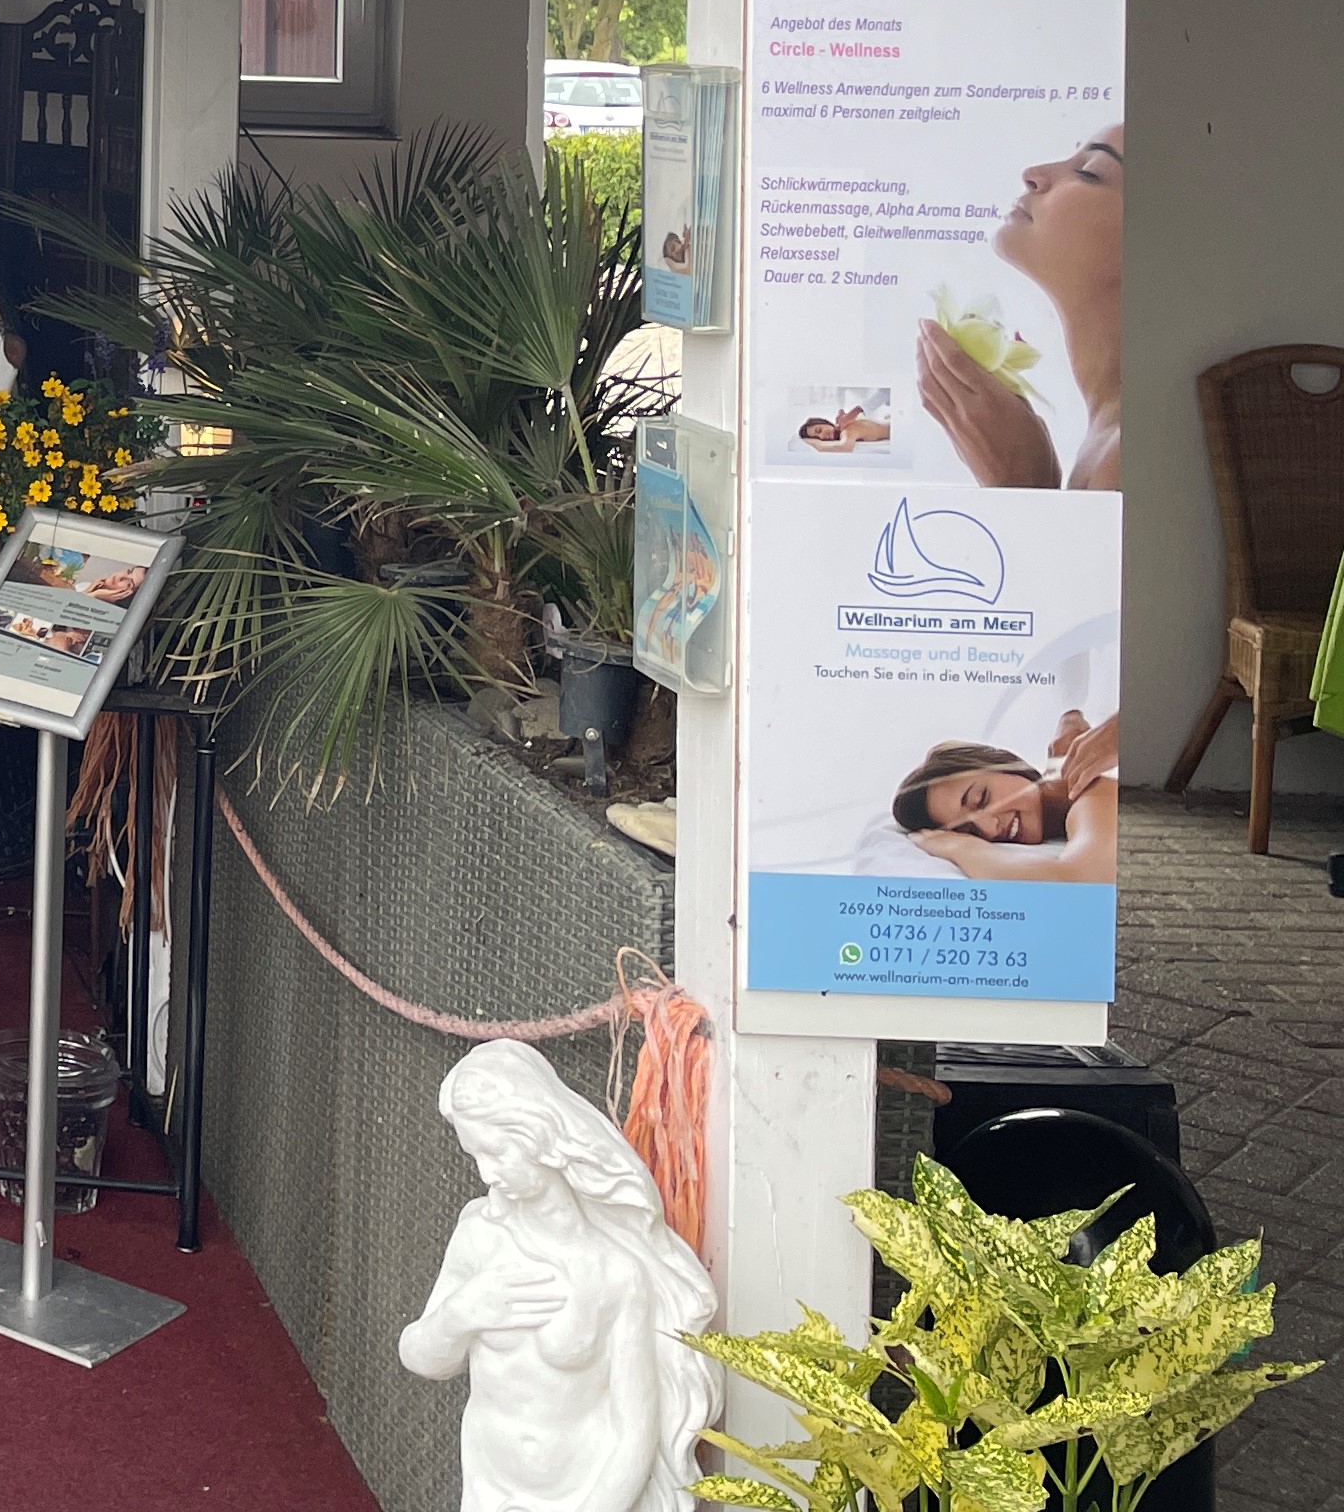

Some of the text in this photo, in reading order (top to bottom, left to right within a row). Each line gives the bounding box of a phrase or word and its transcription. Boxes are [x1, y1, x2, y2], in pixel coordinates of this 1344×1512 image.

[770, 16, 902, 32] Angebot des Monats
[770, 41, 815, 57] Circle
[829, 42, 900, 58] Wellness
[762, 81, 770, 94] 6
[775, 81, 833, 95] Wellness
[836, 82, 930, 99] Anwendungen
[934, 86, 962, 98] zum
[966, 84, 1046, 101] Sonderpreis
[1049, 87, 1063, 101] p.
[1082, 86, 1099, 100] 69
[1103, 87, 1113, 100] €
[762, 105, 960, 123] maximal 6 Personen zeitgleich
[761, 177, 910, 195] Schlickwärmepackung,
[760, 200, 873, 217] Rückenmassage,
[876, 203, 914, 219] Alpha
[917, 204, 960, 217] Aroma
[760, 223, 848, 239] Schwebebett,
[760, 246, 839, 261] Relaxsessel
[764, 270, 898, 285] Dauer ca. 2 Stunden
[845, 611, 1026, 631] Wellnarium am Meer
[845, 643, 1024, 666] Massage und Beauty
[814, 665, 1056, 685] Tauchen Sie ein in die Wellness Welt
[877, 887, 987, 901] Nordseeallee 35
[839, 902, 1026, 921] 26969 Nordseebad Tossens
[870, 923, 993, 943] 04736 / 1374
[870, 946, 1027, 967] 0171 / 520 73 63
[834, 971, 1029, 988] www.wellnarium-am-meer.de
